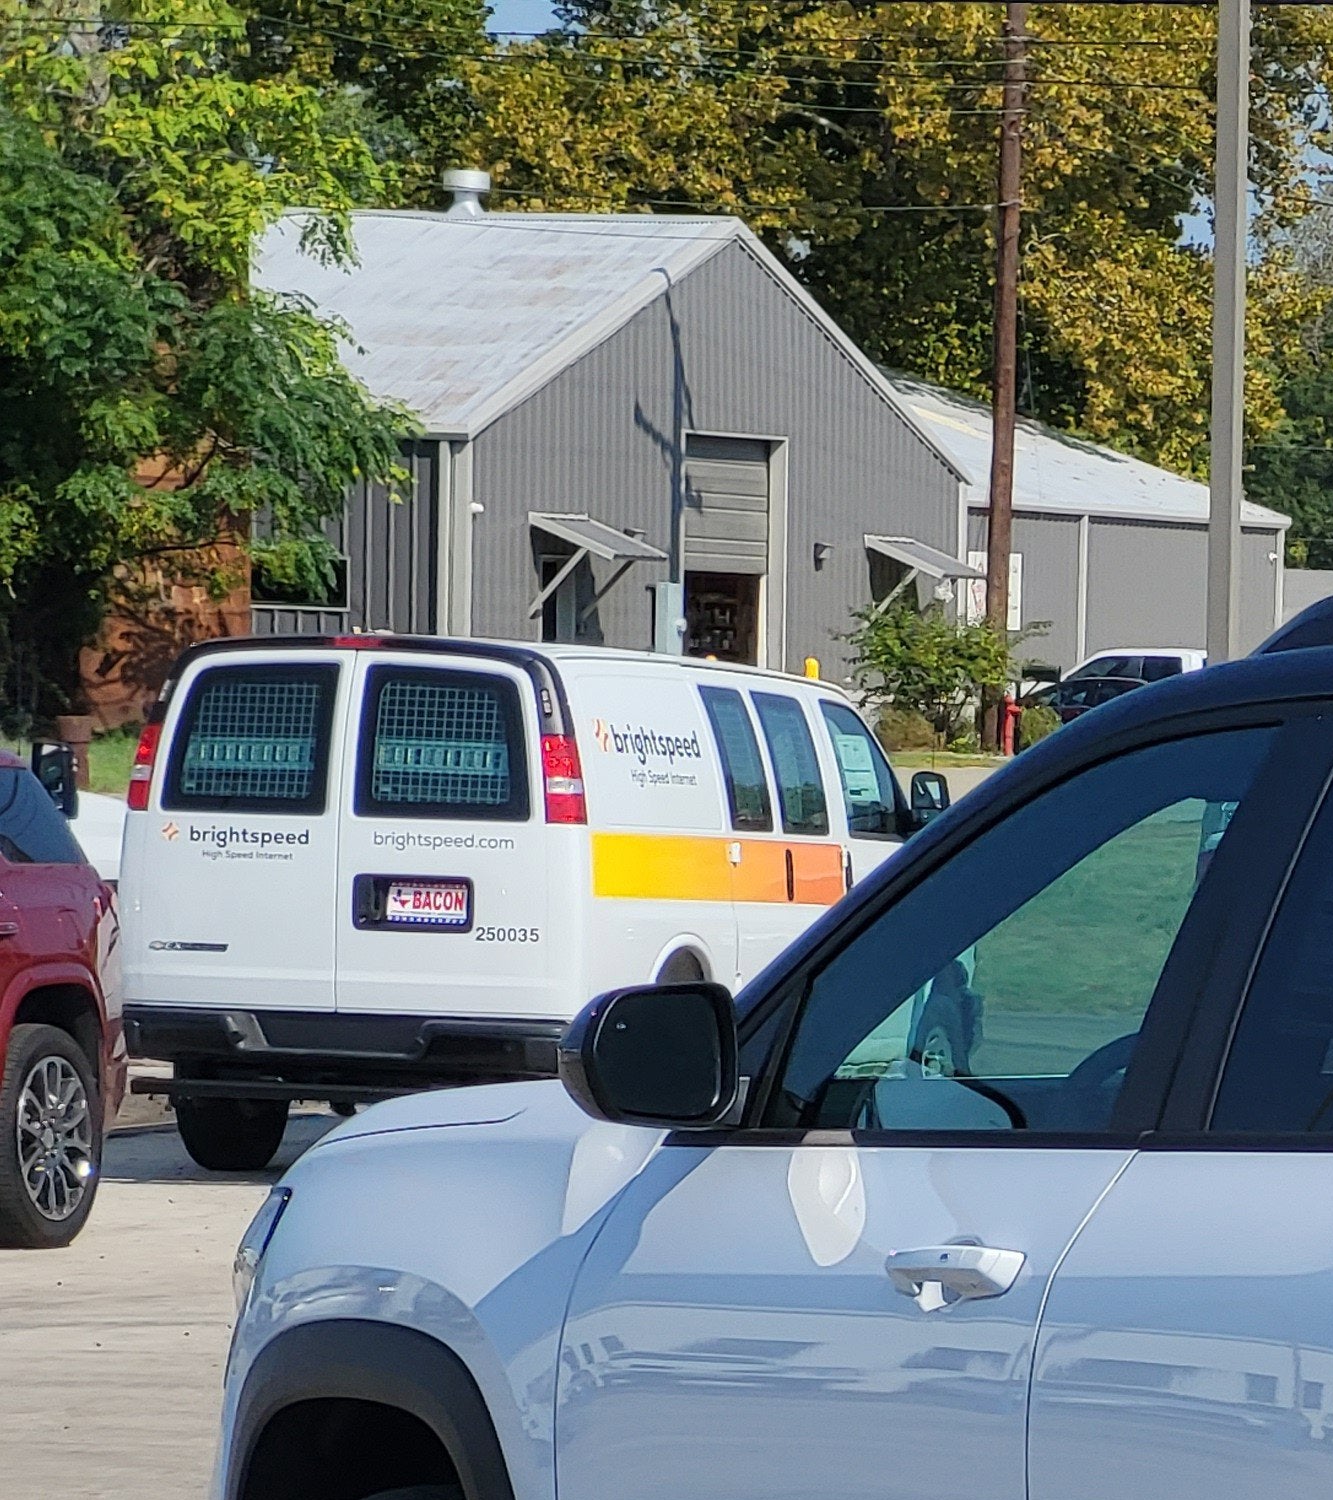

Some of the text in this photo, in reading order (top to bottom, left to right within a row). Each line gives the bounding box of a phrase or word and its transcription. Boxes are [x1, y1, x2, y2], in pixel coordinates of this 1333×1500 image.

[610, 723, 702, 766] brightspeed
[189, 825, 310, 848] brightspeed
[373, 831, 515, 851] brightspeed.com
[202, 850, 293, 861] High Speed Internet
[412, 889, 465, 912] BACON
[475, 927, 540, 943] 250035
